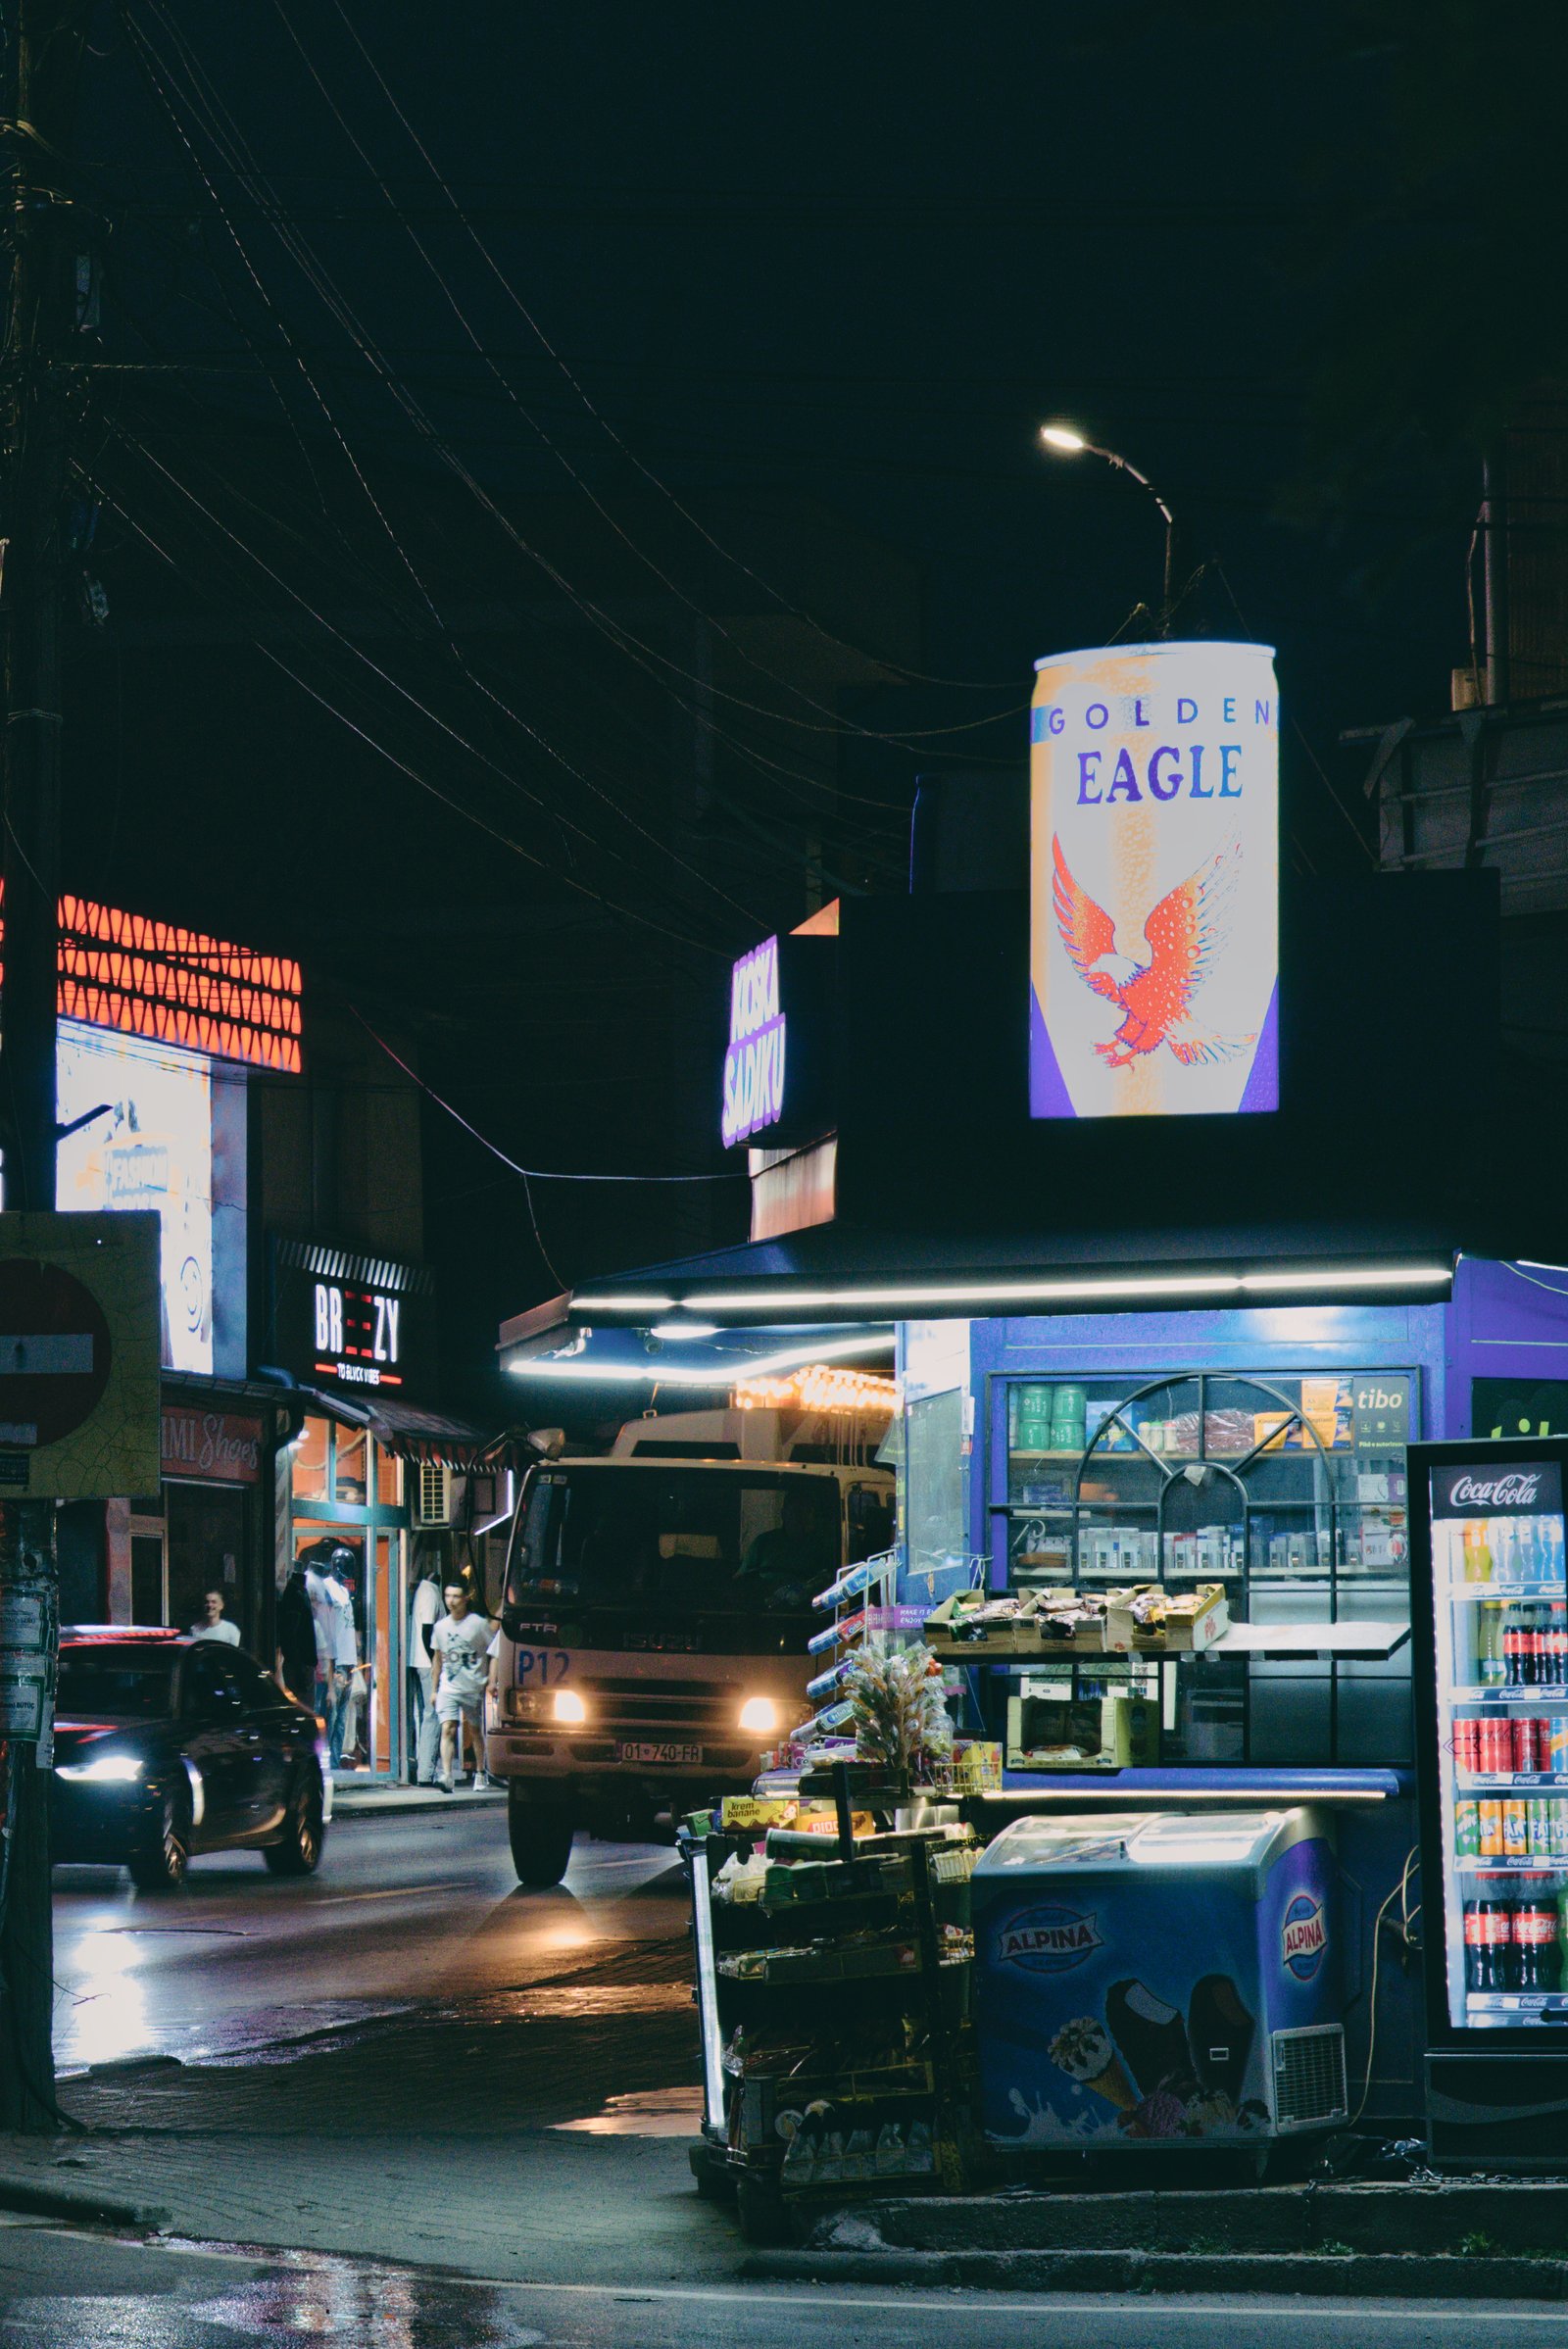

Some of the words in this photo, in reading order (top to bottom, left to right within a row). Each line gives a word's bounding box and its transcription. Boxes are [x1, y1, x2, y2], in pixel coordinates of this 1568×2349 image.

[1049, 698, 1270, 735] GOLDEN
[1077, 745, 1243, 806] EAGLE
[731, 942, 779, 1045] KIOSKA
[724, 1022, 785, 1138] SADIKU
[316, 1284, 399, 1363] BREEZY
[337, 1362, 346, 1380] TO
[1358, 1389, 1401, 1409] tibo
[199, 1413, 258, 1470] Shoes
[1450, 1474, 1543, 1507] Coca-Cola
[519, 1623, 558, 1634] FTR
[518, 1650, 570, 1686] P12
[625, 1744, 640, 1759] 01
[727, 1809, 760, 1818] banane
[731, 1801, 754, 1811] krem
[1006, 1925, 1093, 1953] ALPINA
[1287, 1920, 1323, 1954] ALPINA
